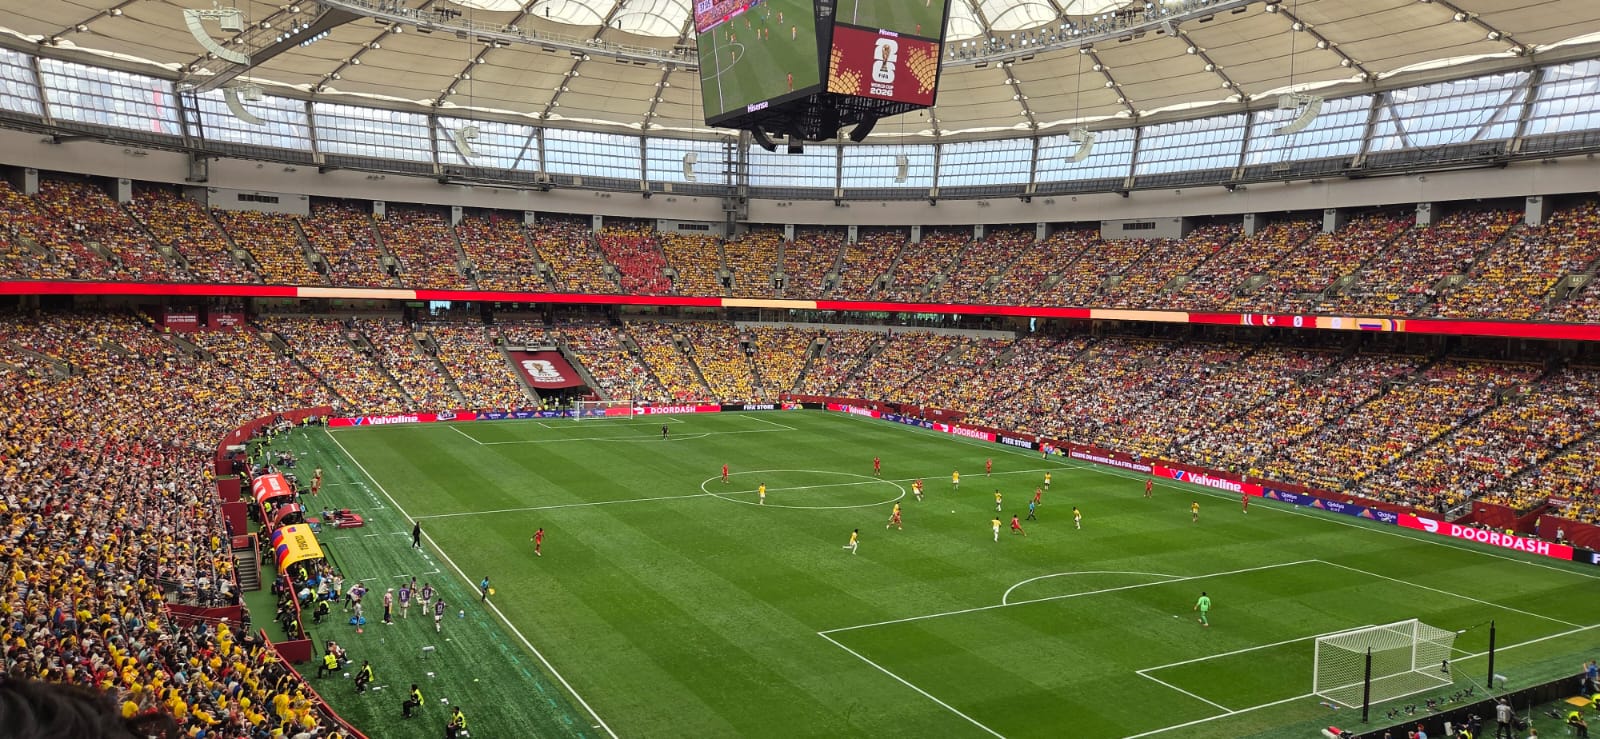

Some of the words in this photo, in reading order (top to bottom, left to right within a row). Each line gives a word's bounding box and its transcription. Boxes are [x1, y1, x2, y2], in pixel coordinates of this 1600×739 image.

[870, 87, 893, 96] 2026
[747, 101, 769, 113] Hisense
[651, 405, 696, 414] DOORDASH
[368, 415, 418, 425] Valvoline
[952, 426, 989, 441] DOORDASH
[1015, 438, 1032, 449] STORE
[1187, 472, 1242, 492] Valvoline
[1451, 524, 1550, 555] DOORDASH
